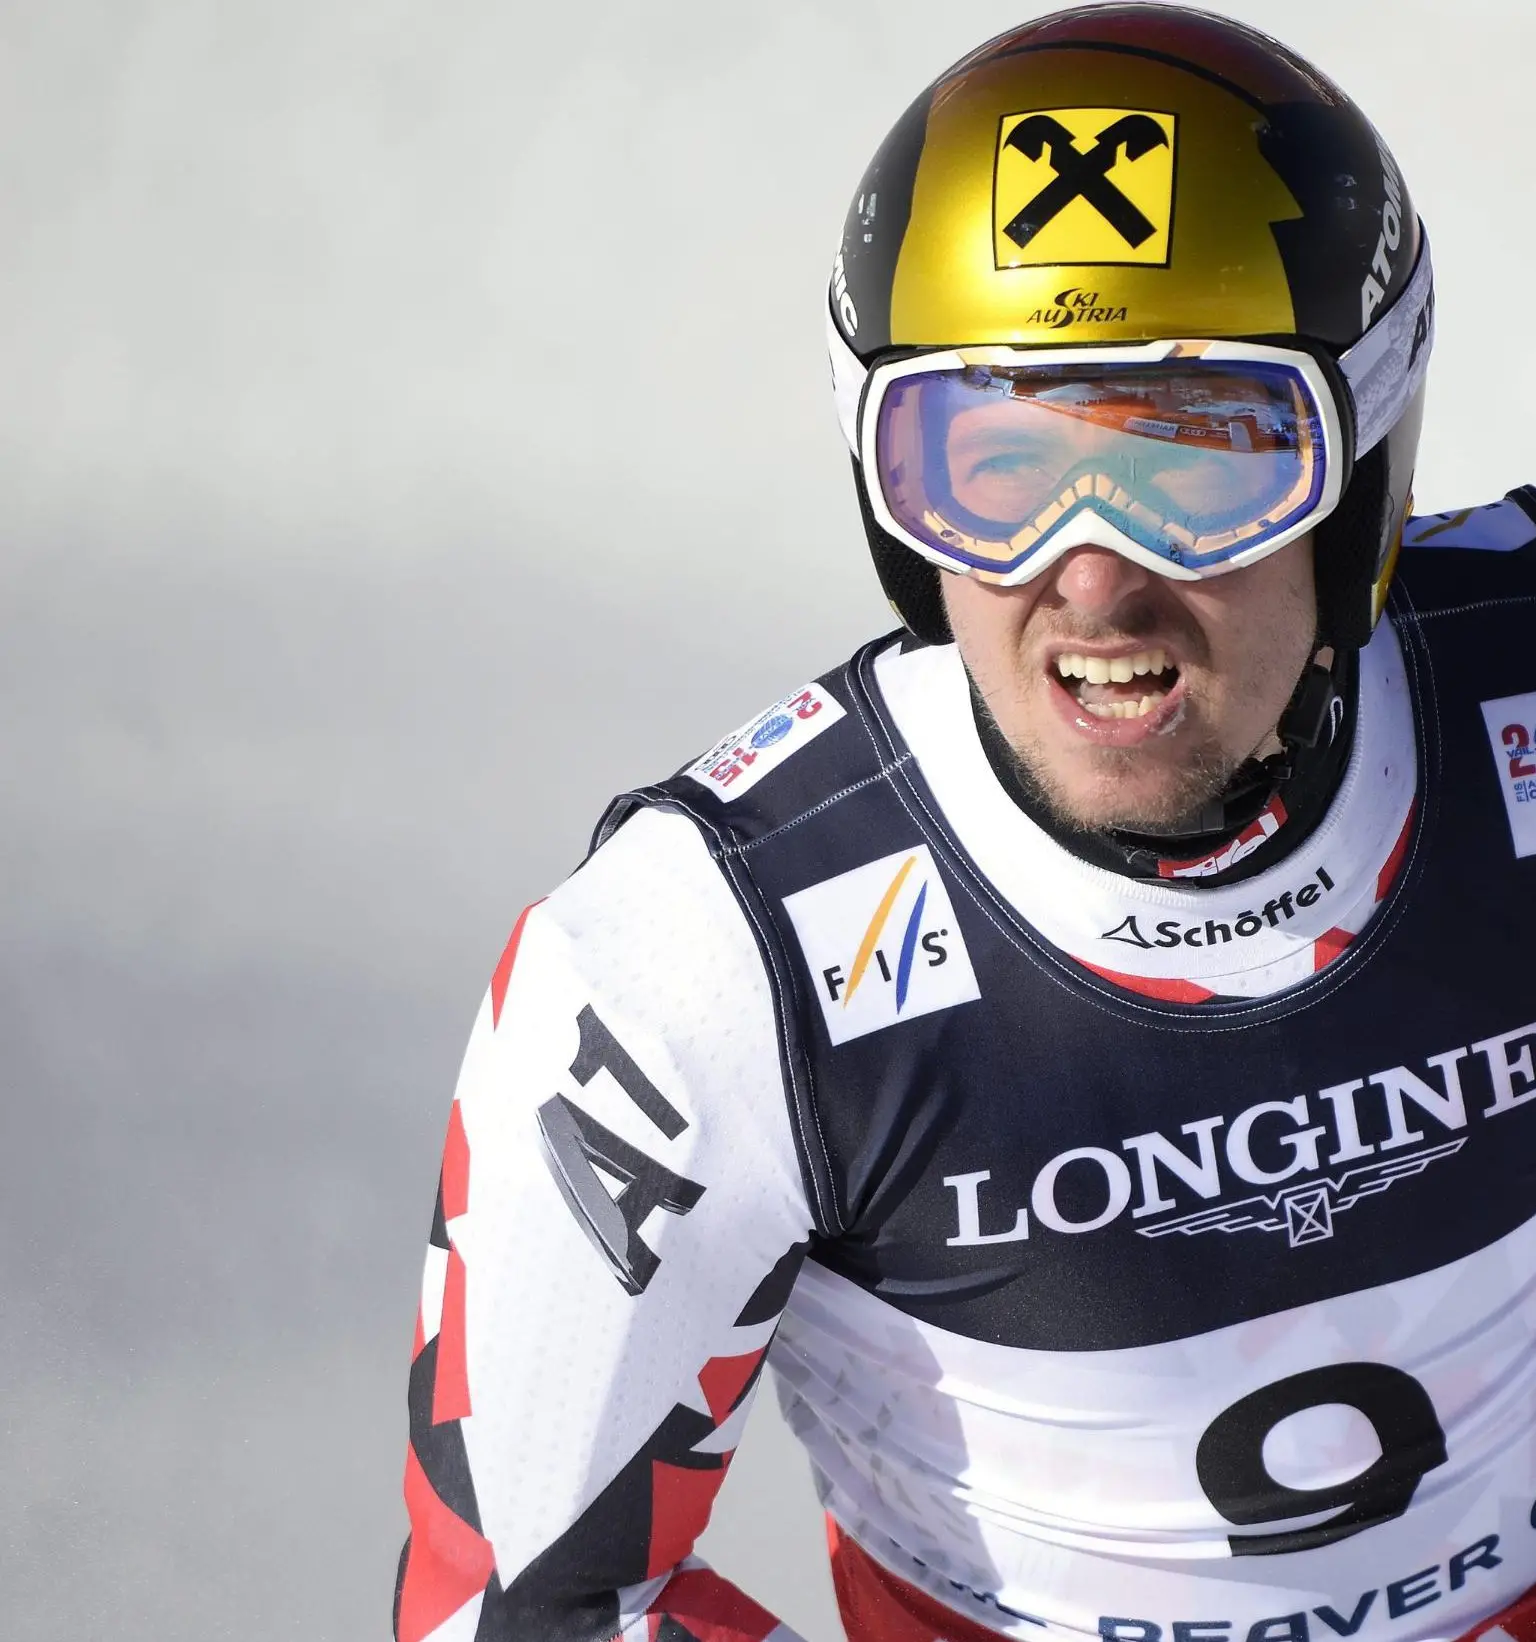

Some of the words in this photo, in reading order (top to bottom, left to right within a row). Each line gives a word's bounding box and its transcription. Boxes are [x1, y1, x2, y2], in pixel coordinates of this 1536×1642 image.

[1026, 306, 1128, 329] AUSTRIA
[1195, 1361, 1448, 1558] 9
[1099, 1534, 1504, 1642] BEAVER
